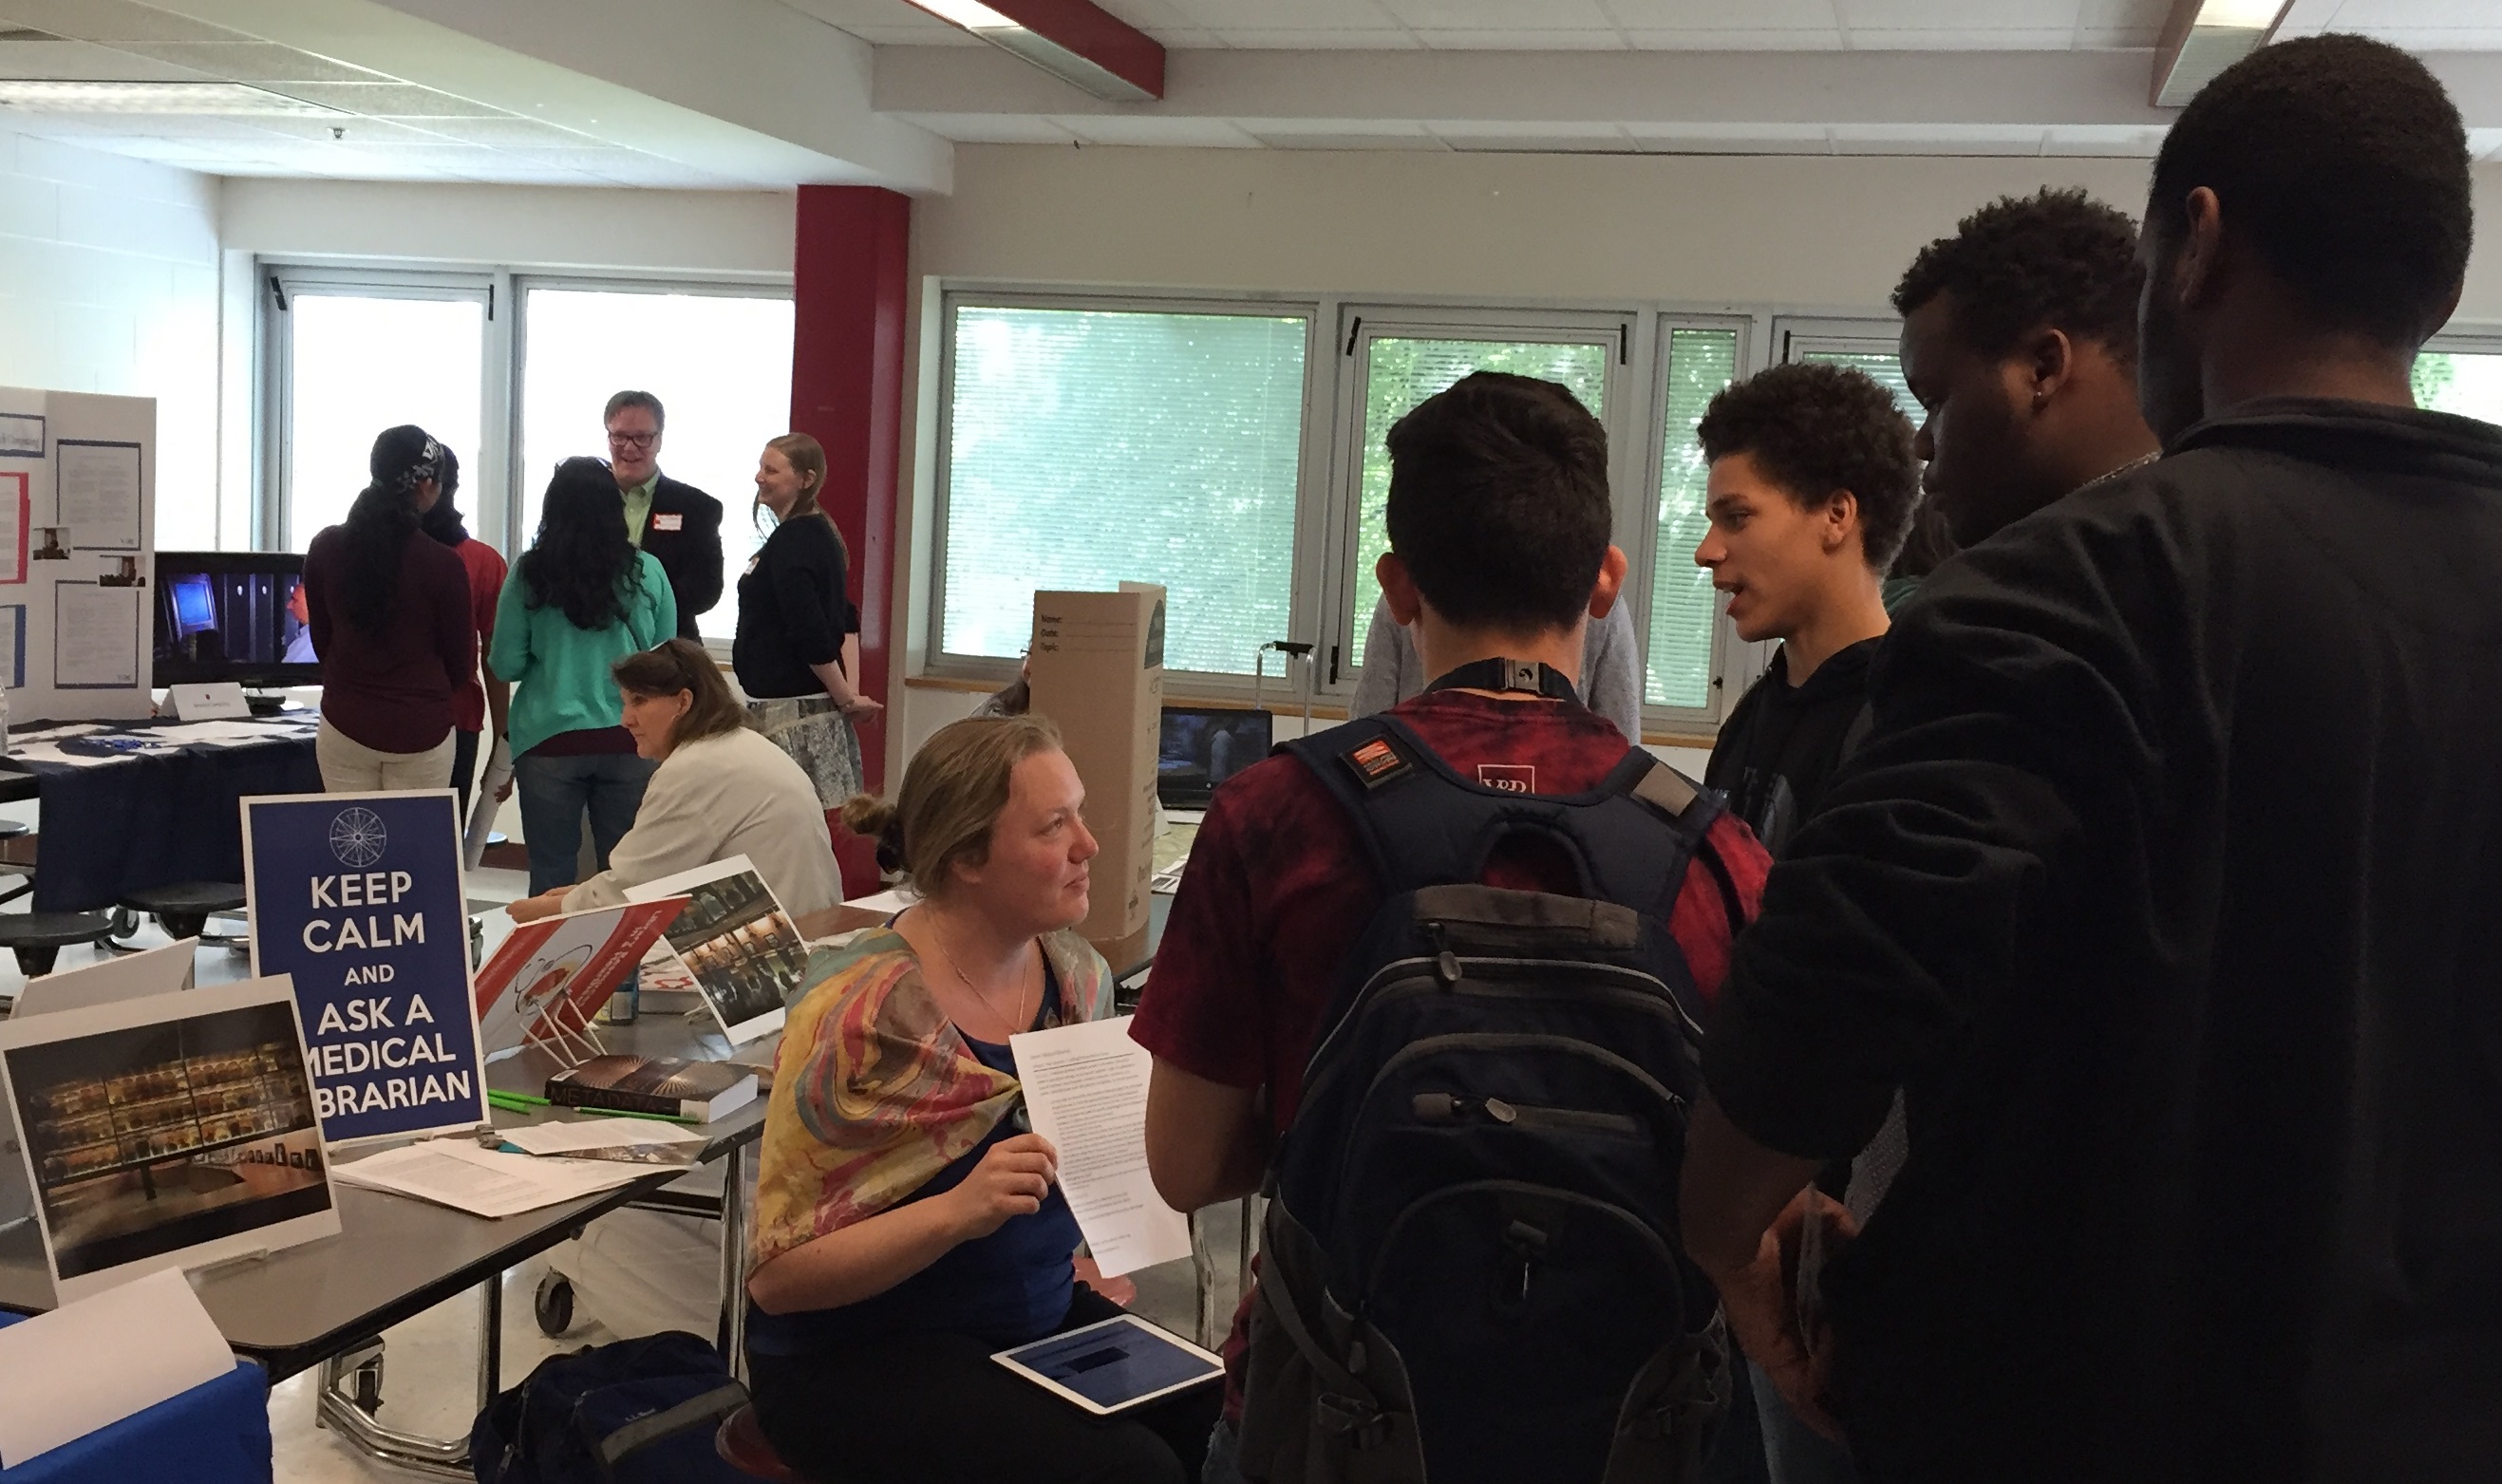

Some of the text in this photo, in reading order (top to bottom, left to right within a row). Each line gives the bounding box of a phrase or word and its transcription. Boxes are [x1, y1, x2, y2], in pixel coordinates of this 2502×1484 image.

[311, 871, 412, 910] KEEP
[302, 912, 425, 952] CALM
[344, 964, 395, 986] AND
[317, 994, 434, 1035] ASK A
[315, 1070, 471, 1118] BRARIAN
[553, 1087, 655, 1110] METADATA
